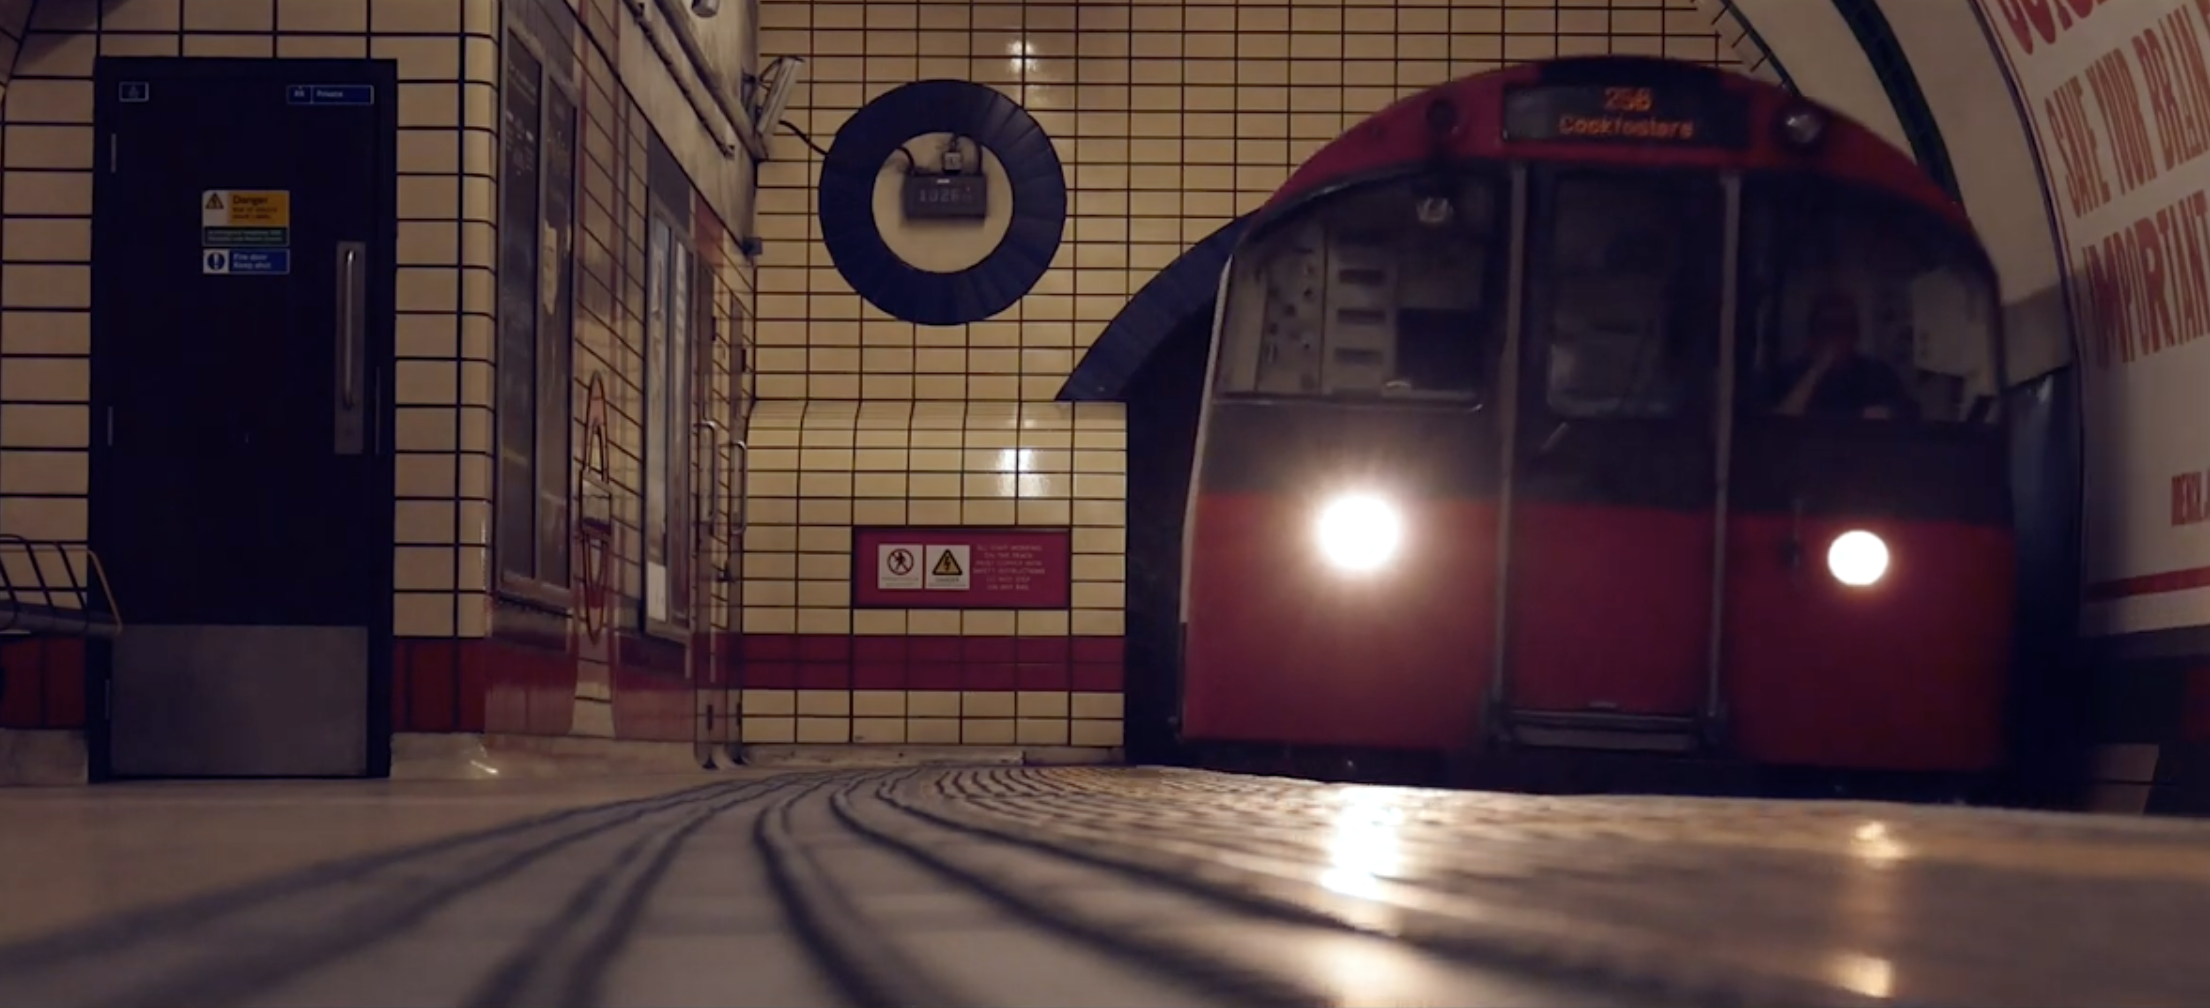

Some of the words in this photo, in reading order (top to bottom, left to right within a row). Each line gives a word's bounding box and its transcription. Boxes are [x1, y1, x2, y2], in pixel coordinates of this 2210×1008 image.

[1558, 115, 1694, 139] Cockfosters
[2046, 77, 2110, 218] SAVE
[2086, 48, 2156, 195] YOUR
[233, 195, 268, 206] Danger
